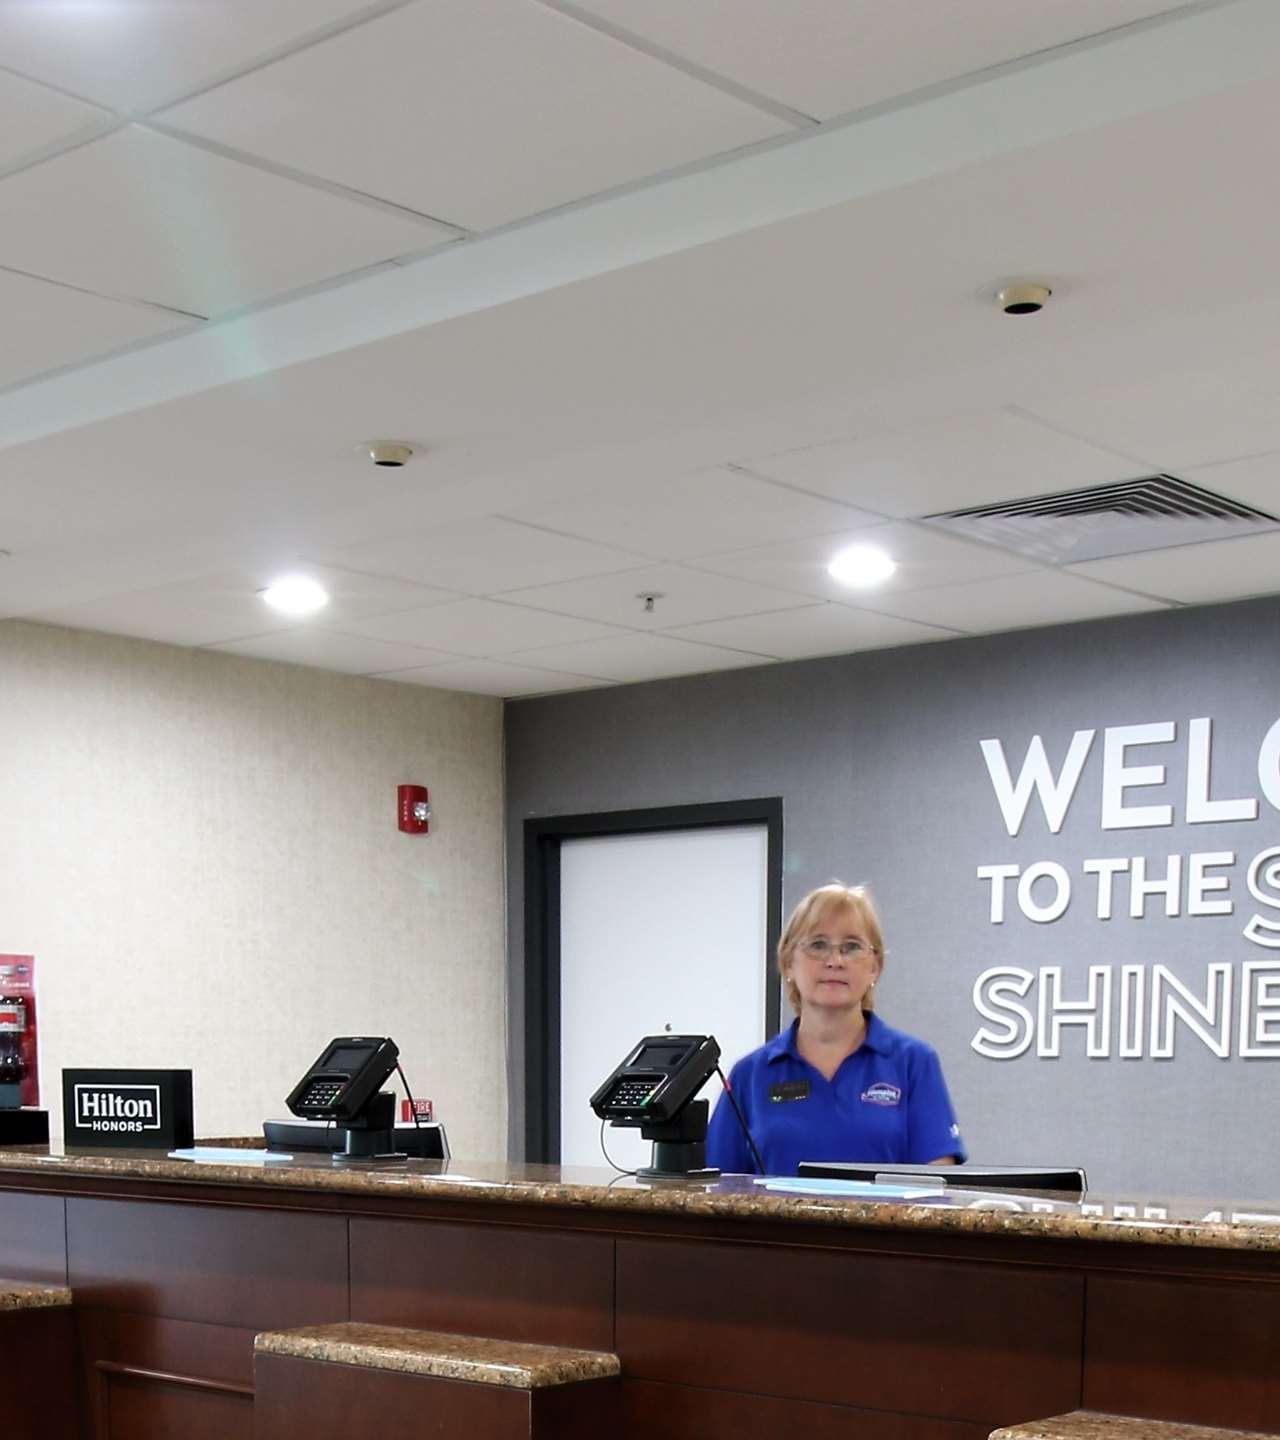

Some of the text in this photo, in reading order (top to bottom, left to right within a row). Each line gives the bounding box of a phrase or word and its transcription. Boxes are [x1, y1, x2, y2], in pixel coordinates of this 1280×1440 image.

[976, 860, 1072, 923] TO
[1082, 851, 1236, 919] THE
[82, 1092, 154, 1118] Hilton
[92, 1120, 144, 1132] HONORS
